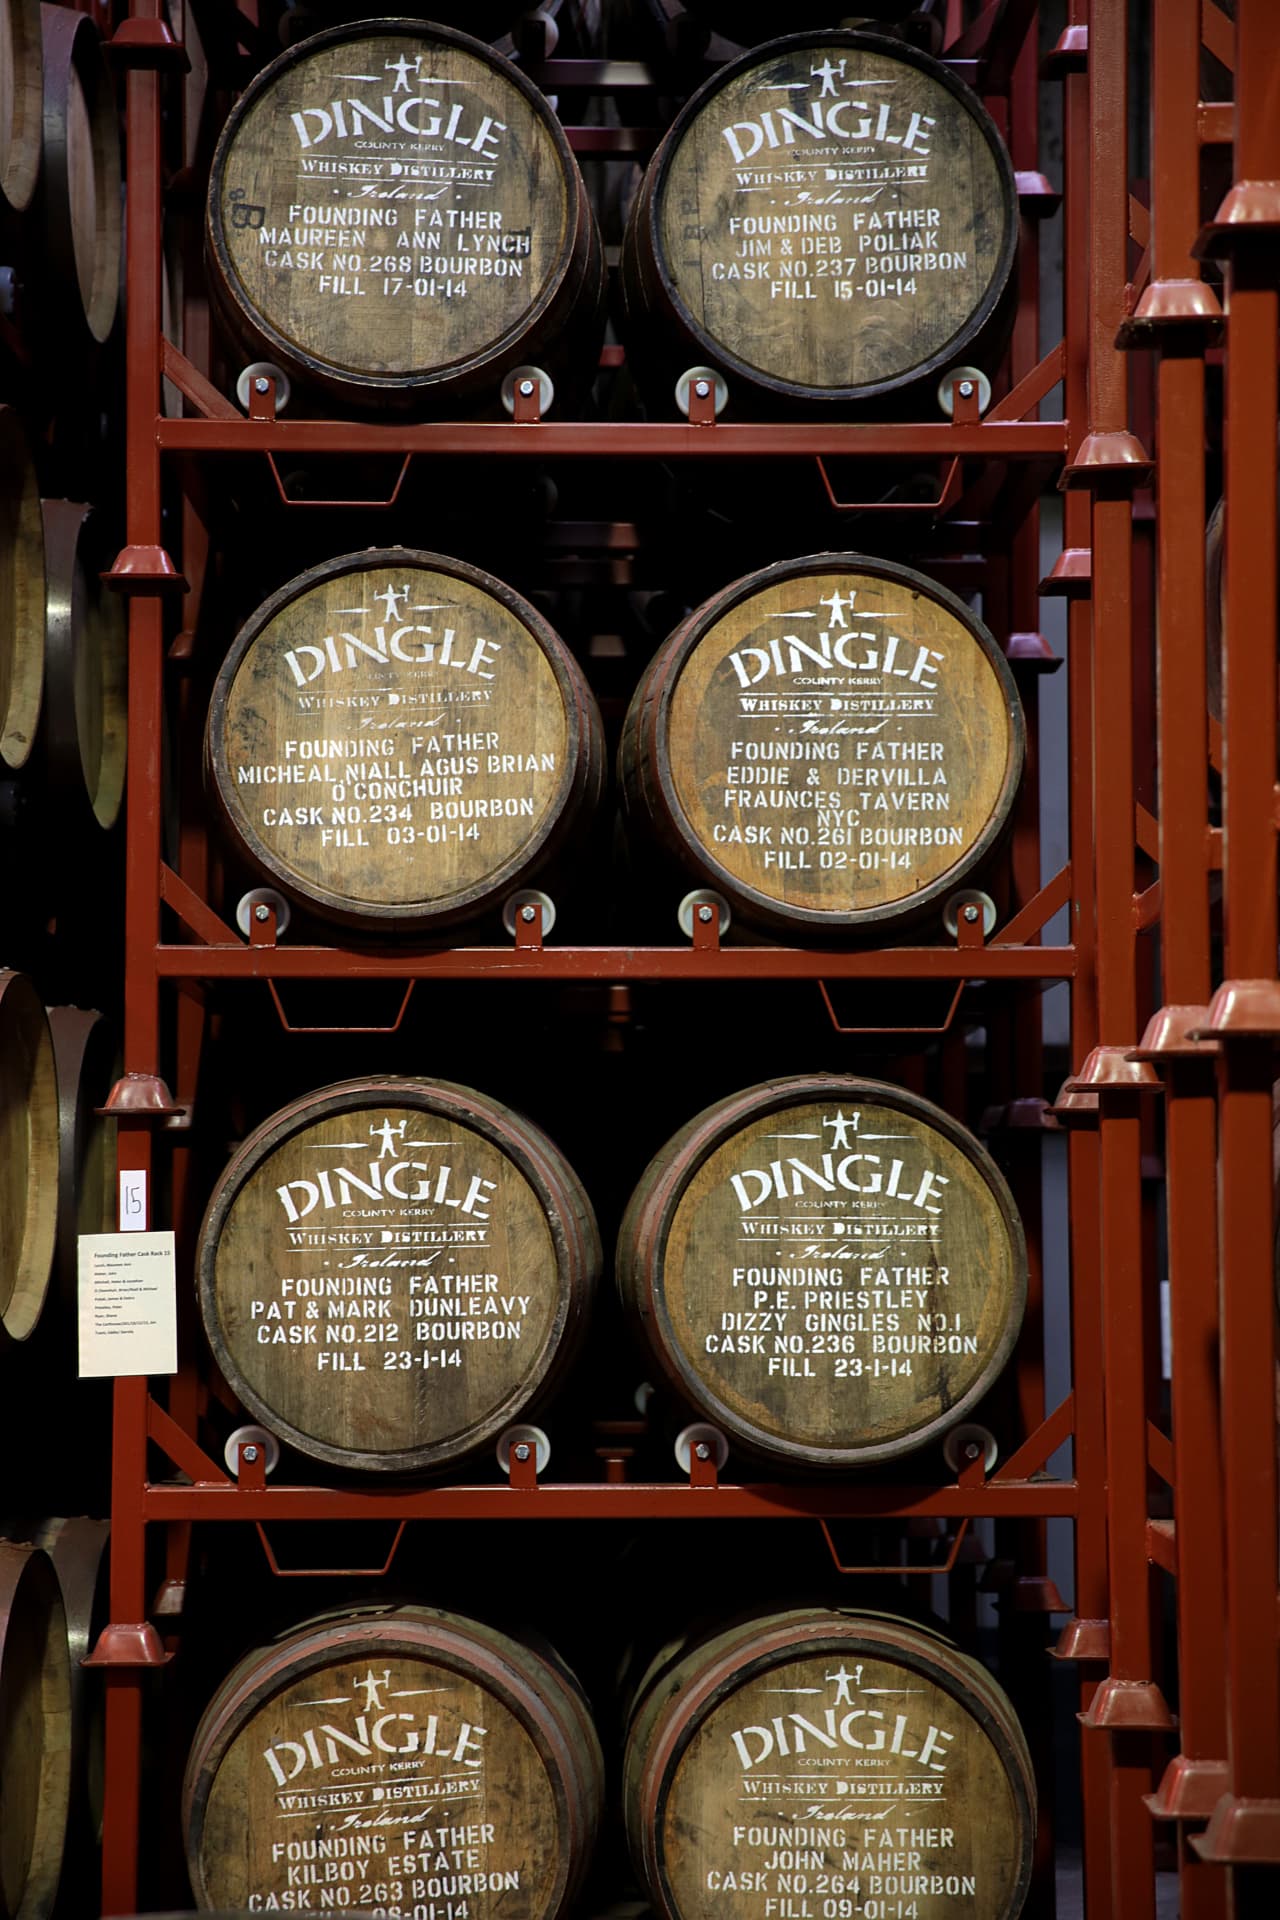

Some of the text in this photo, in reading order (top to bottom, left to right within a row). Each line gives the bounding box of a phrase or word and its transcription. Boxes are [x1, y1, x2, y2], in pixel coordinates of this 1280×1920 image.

[291, 96, 507, 158] DINGLE
[722, 101, 936, 164] DINGLE
[354, 141, 406, 150] COUNTY
[302, 159, 496, 180] WHISKEY DISTILLERY
[736, 166, 928, 185] WHISKEY DISTILLERY
[348, 184, 449, 201] Ireland
[783, 189, 884, 207] Ireland
[289, 205, 502, 230] FOUNDING FATHER
[730, 209, 940, 235] FOUNDING FATHER
[259, 227, 530, 254] MAUREEN ANN LYNCH
[736, 232, 938, 258] JIM & DEB POLIAK
[265, 251, 324, 271] CASK
[420, 256, 522, 277] BOURBON
[712, 262, 771, 280] CASK
[866, 252, 967, 274] BOURBON
[319, 276, 467, 297] FILL 17-01-14
[771, 281, 817, 299] FILL
[284, 626, 501, 687] DINGLE
[729, 632, 944, 689] DINGLE
[299, 690, 492, 708] WHISKEY DISTILLERY
[740, 698, 935, 711] WHISKEY DISTILLERY
[789, 720, 889, 735] Ireland
[285, 732, 499, 759] FOUNDING FATHER
[732, 742, 944, 761] FOUNDING FATHER
[420, 756, 478, 777] AGUS
[488, 753, 555, 774] BRIAN
[728, 767, 947, 786] EDDIE & DERVILLA
[354, 778, 462, 799] CONCHUIR
[725, 789, 949, 811] FRAUNCES TAVERN
[263, 807, 323, 826] CASK
[431, 798, 534, 819] BOURBON
[817, 809, 860, 828] NYC
[322, 824, 479, 847] FILL 03-01-14
[714, 826, 771, 844] CASK
[860, 828, 962, 845] BOURBON
[765, 851, 911, 869] FILL 02-01-14
[276, 1161, 497, 1222] DINGLE
[730, 1154, 949, 1214] DINGLE
[125, 1185, 142, 1215] 15
[795, 1201, 847, 1209] COUNTY
[343, 1208, 434, 1218] COUNTY KERRY
[289, 1229, 487, 1245] WHISKEY DISTILLERY
[741, 1222, 939, 1236] WHISKEY DISTILLERY
[338, 1251, 442, 1269] Ireland
[790, 1246, 891, 1260] Ireland
[282, 1274, 498, 1297] FOUNDING FATHER
[733, 1267, 949, 1287] FOUNDING FATHER
[251, 1296, 530, 1320] PAT & MARK DUNLEAVY
[754, 1291, 928, 1309] P.E. PRIESTLEY
[258, 1325, 317, 1344] CASK
[417, 1321, 521, 1341] BOURBON
[722, 1313, 786, 1331] DIZZY
[806, 1313, 899, 1332] GINGLES
[706, 1335, 765, 1354] CASK
[873, 1336, 977, 1354] BOURBON
[318, 1349, 461, 1371] FILL 23-1-14
[769, 1358, 912, 1377] FILL 23-1-14
[263, 1714, 488, 1786] DINGLE
[731, 1709, 954, 1771] DINGLE
[332, 1760, 426, 1777] COUNTY KERRY
[797, 1758, 891, 1767] COUNTY KERRY
[278, 1779, 480, 1810] WHISKEY DISTILLERY
[744, 1781, 944, 1794] WHISKEY DISTILLERY
[331, 1807, 432, 1831] Ireland
[792, 1805, 896, 1821] Ireland
[273, 1824, 494, 1862] FOUNDING FATHER
[734, 1827, 954, 1848] FOUNDING FATHER
[288, 1849, 479, 1886] KILBOY ESTATE
[765, 1851, 920, 1871] JOHN MAHER
[249, 1891, 309, 1913] CASK
[412, 1870, 519, 1899] BOURBON
[708, 1872, 767, 1892] CASK
[870, 1876, 975, 1895] BOURBON
[765, 1899, 918, 1919] FILL 09-01-14
